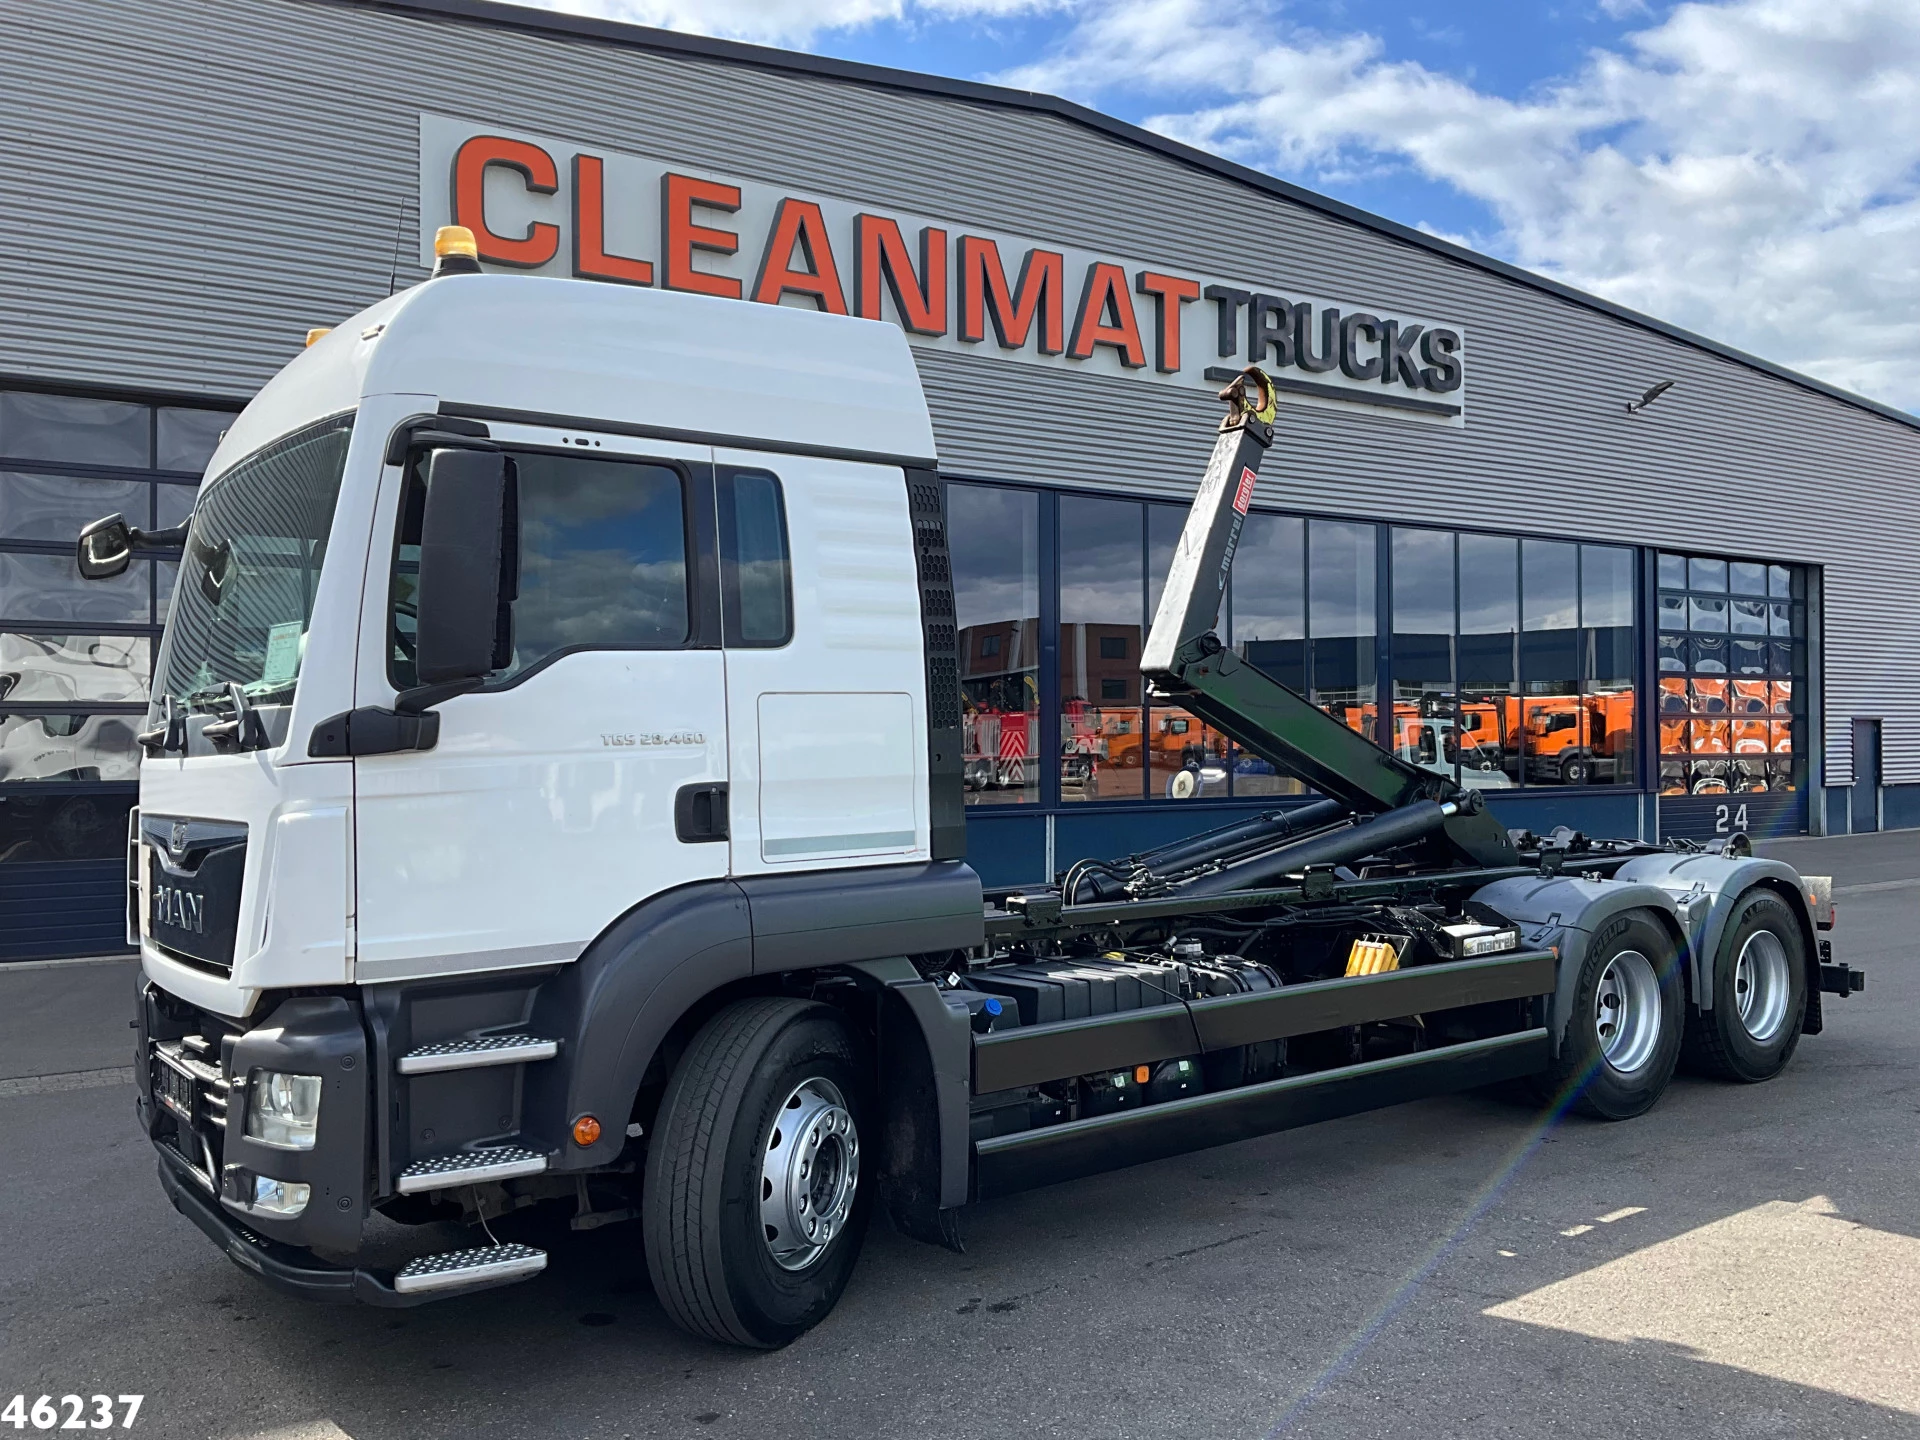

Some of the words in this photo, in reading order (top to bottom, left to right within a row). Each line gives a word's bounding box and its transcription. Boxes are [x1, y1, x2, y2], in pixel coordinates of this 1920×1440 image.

[450, 135, 1199, 373] CLEANMAT
[1204, 284, 1461, 393] TRUCKS
[1221, 512, 1243, 571] marrel
[600, 733, 636, 746] TGS
[1715, 803, 1749, 832] 24
[153, 885, 203, 933] MAN
[1583, 918, 1627, 988] MICHELIN
